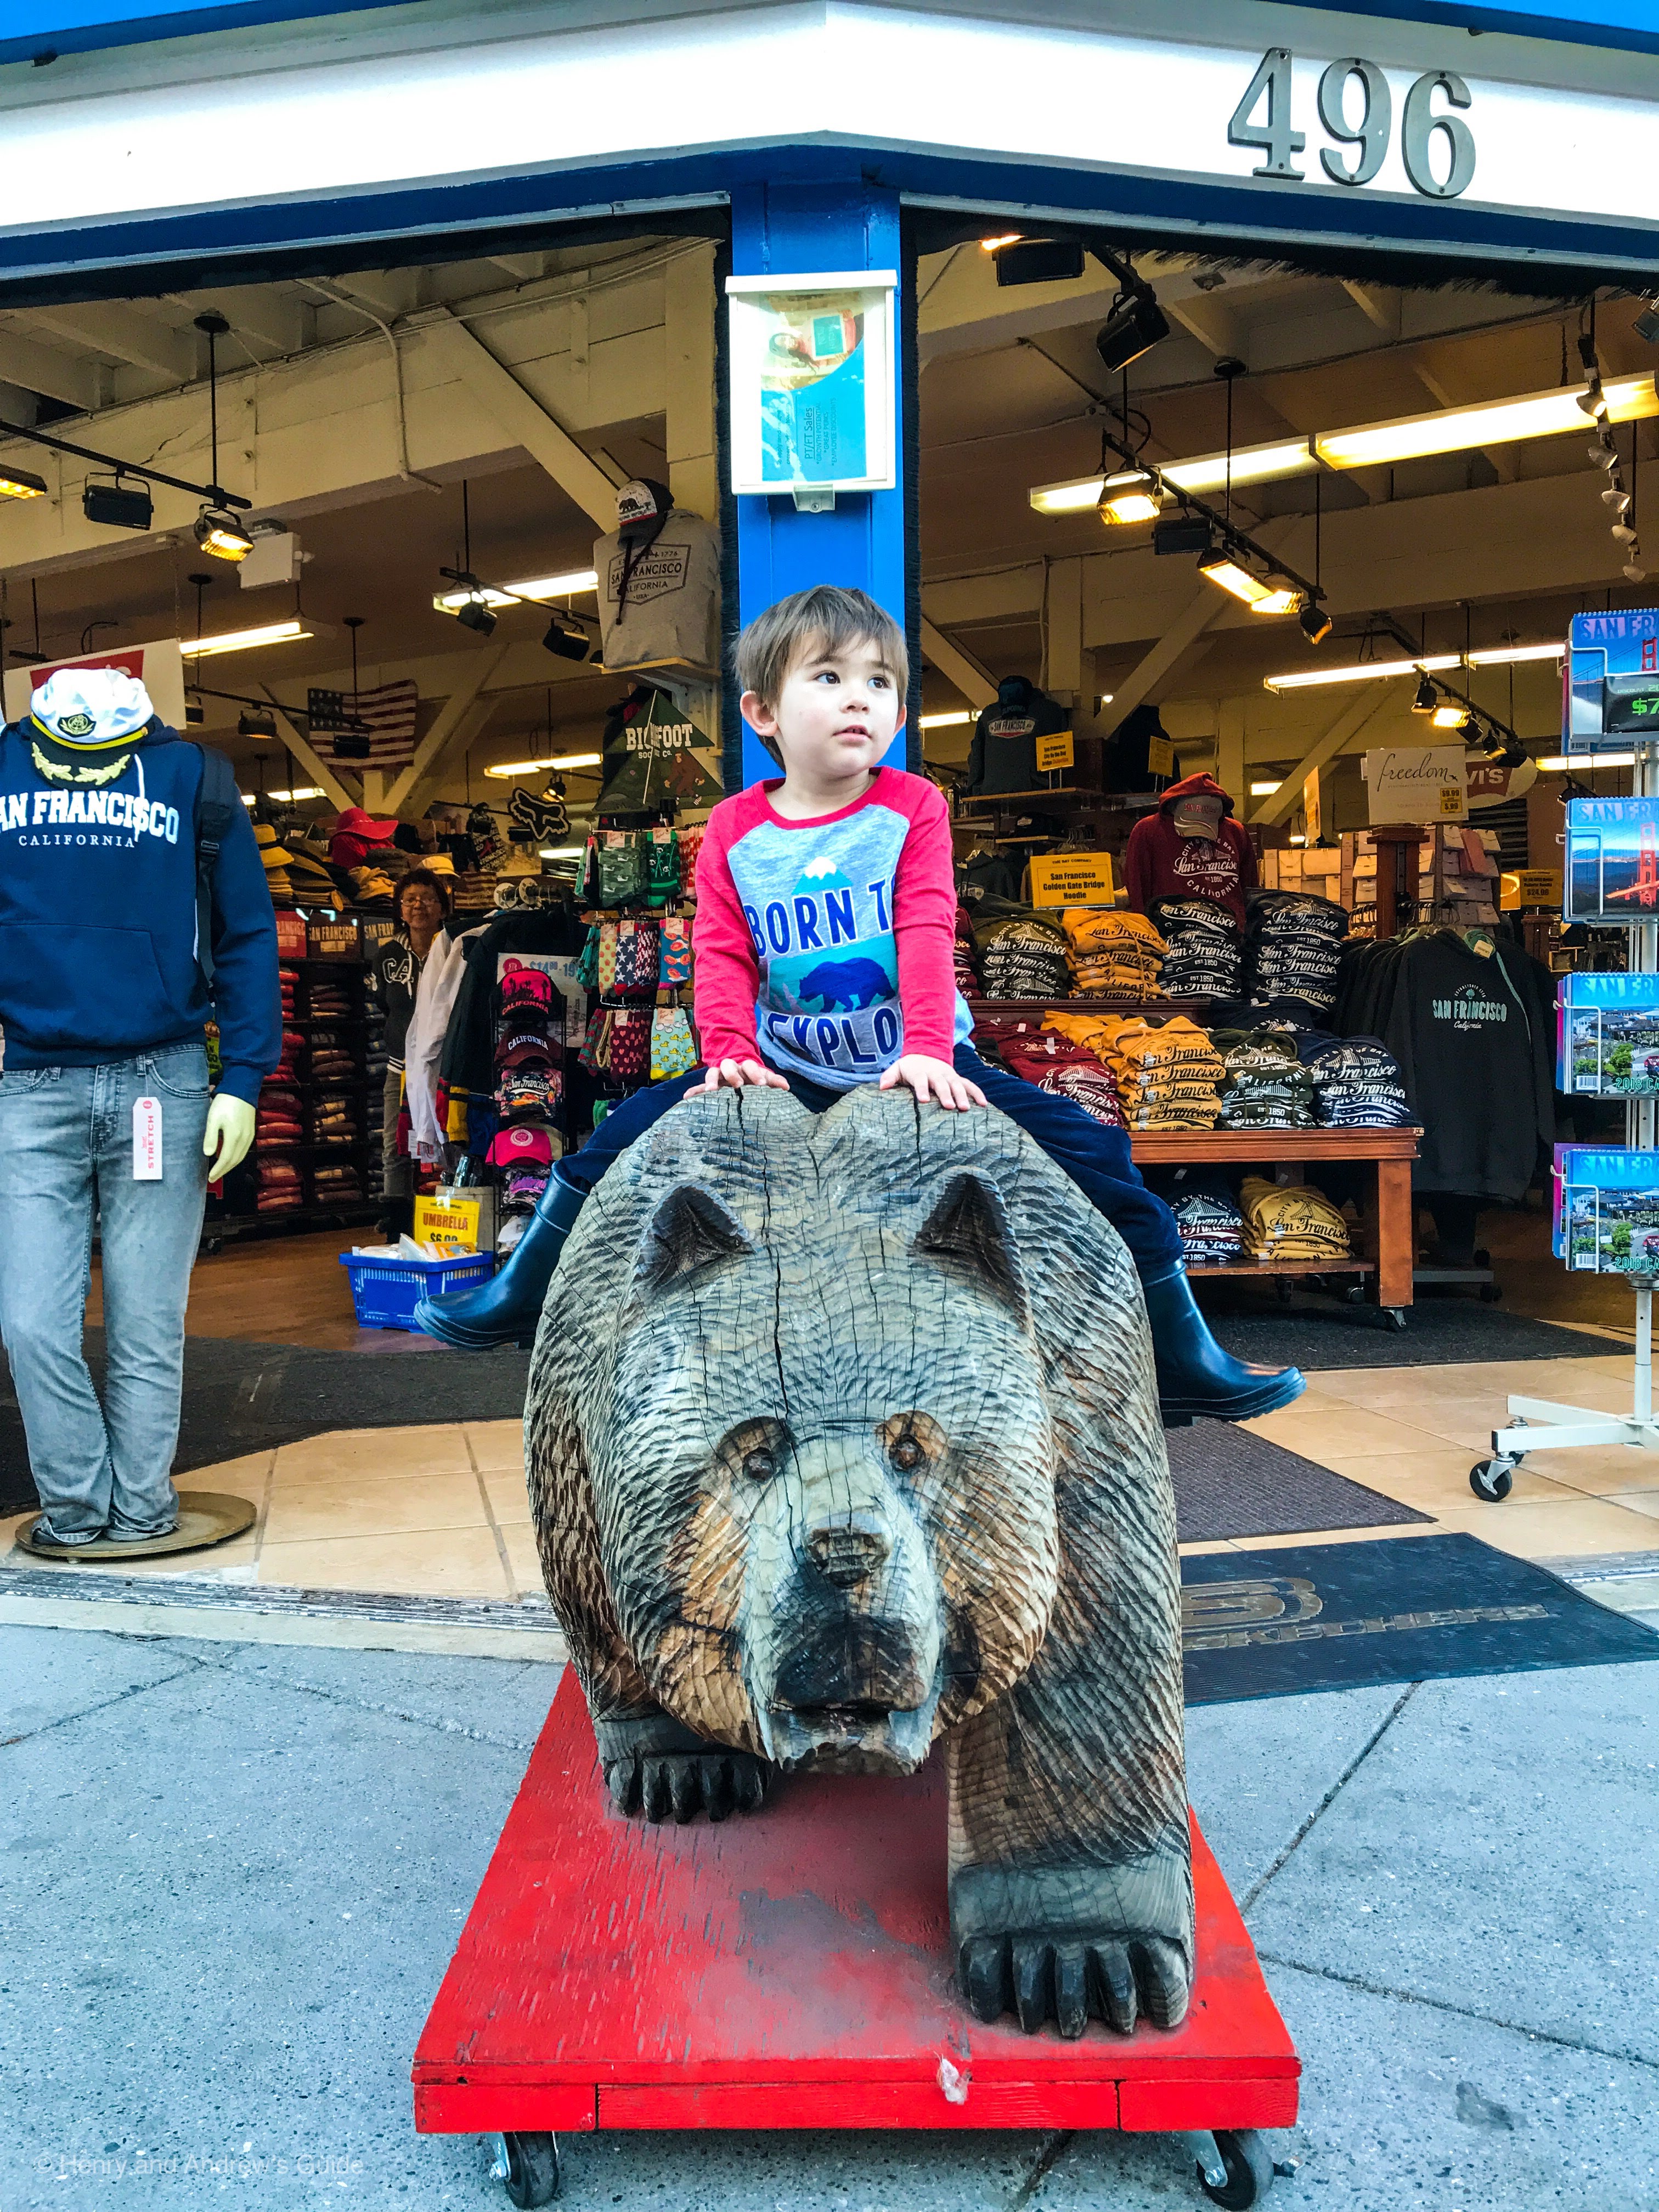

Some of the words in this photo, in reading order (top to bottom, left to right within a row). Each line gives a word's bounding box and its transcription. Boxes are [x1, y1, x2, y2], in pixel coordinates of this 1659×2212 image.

[1228, 47, 1476, 200] 496
[804, 408, 812, 431] Sales
[804, 433, 814, 460] PT/FT
[632, 562, 682, 577] RANCISCO
[626, 580, 668, 593] ALIFORNIA
[1579, 617, 1618, 640] SAN
[1627, 615, 1659, 637] FR
[1377, 753, 1452, 792] freedom
[1466, 768, 1504, 786] VI'S
[0, 792, 28, 833] AN
[32, 789, 179, 844] FRANCISCO
[1578, 803, 1617, 822] SAN
[1626, 802, 1659, 821] FR
[19, 834, 135, 848] CALIFORNIA
[1223, 841, 1235, 854] BAY
[1050, 872, 1063, 881] San
[1064, 871, 1096, 879] Francisco
[1043, 883, 1066, 891] Golden
[1083, 881, 1105, 889] Bridge
[1063, 891, 1087, 900] Hoodie
[743, 887, 859, 957] BORN
[867, 873, 895, 934] T
[1180, 906, 1237, 928] Francisco
[322, 925, 357, 940] FRANCISCO
[1046, 930, 1060, 943] BAY
[1012, 936, 1067, 956] Francisco
[1307, 937, 1321, 946] 1850
[1284, 945, 1342, 965] Francisco
[1580, 977, 1618, 997] SAN
[1627, 977, 1659, 996] FR
[501, 1000, 549, 1016] CALIFORNIA
[1432, 999, 1452, 1019] SAN
[1454, 1000, 1507, 1022] FRANCISCO
[508, 1035, 549, 1051] CALIFORNIA
[1369, 1047, 1389, 1058] BAY
[1161, 1065, 1225, 1082] Francisco
[509, 1075, 521, 1090] San
[522, 1075, 550, 1092] Francisco
[1615, 1076, 1643, 1091] 2018
[1268, 1107, 1285, 1116] 1850
[1580, 1155, 1618, 1175] SAN
[1627, 1155, 1659, 1175] FR
[1278, 1203, 1292, 1217] CITY
[423, 1212, 468, 1231] UMBRELLA
[1615, 1256, 1643, 1269] 2018
